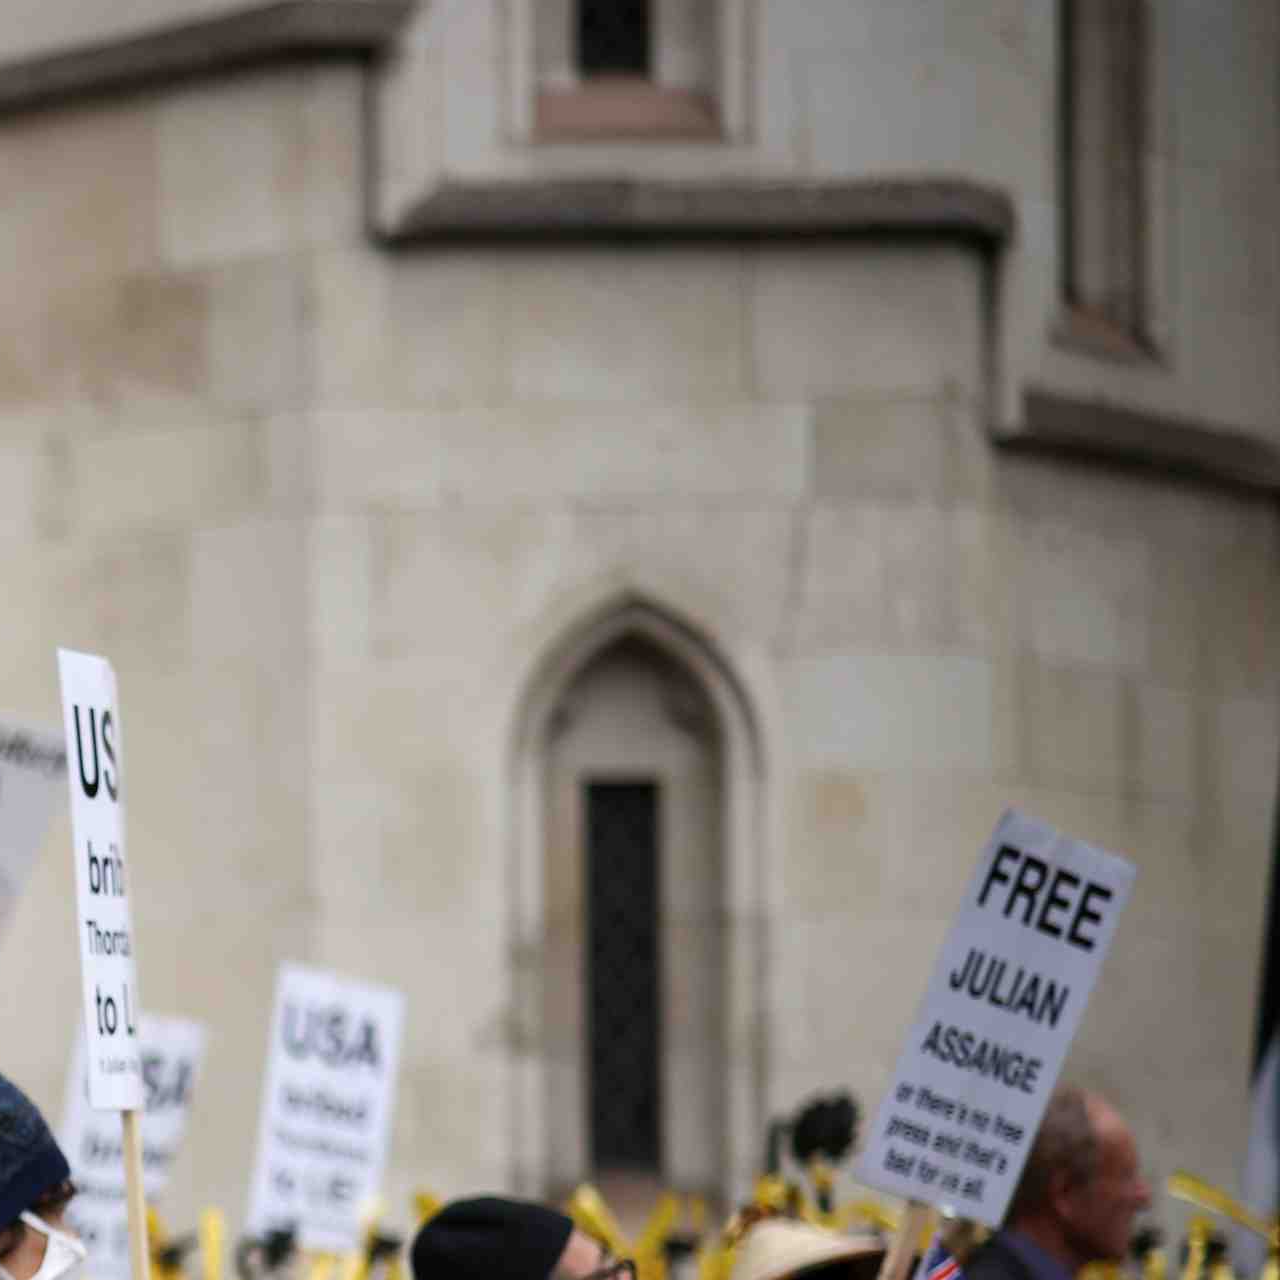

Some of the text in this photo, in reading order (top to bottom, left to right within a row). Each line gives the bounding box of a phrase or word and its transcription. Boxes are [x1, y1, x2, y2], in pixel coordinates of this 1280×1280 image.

[977, 843, 1114, 954] FREE
[95, 984, 117, 1036] to
[949, 947, 1072, 1030] JULIAN
[920, 1021, 1043, 1095] ASSANGE
